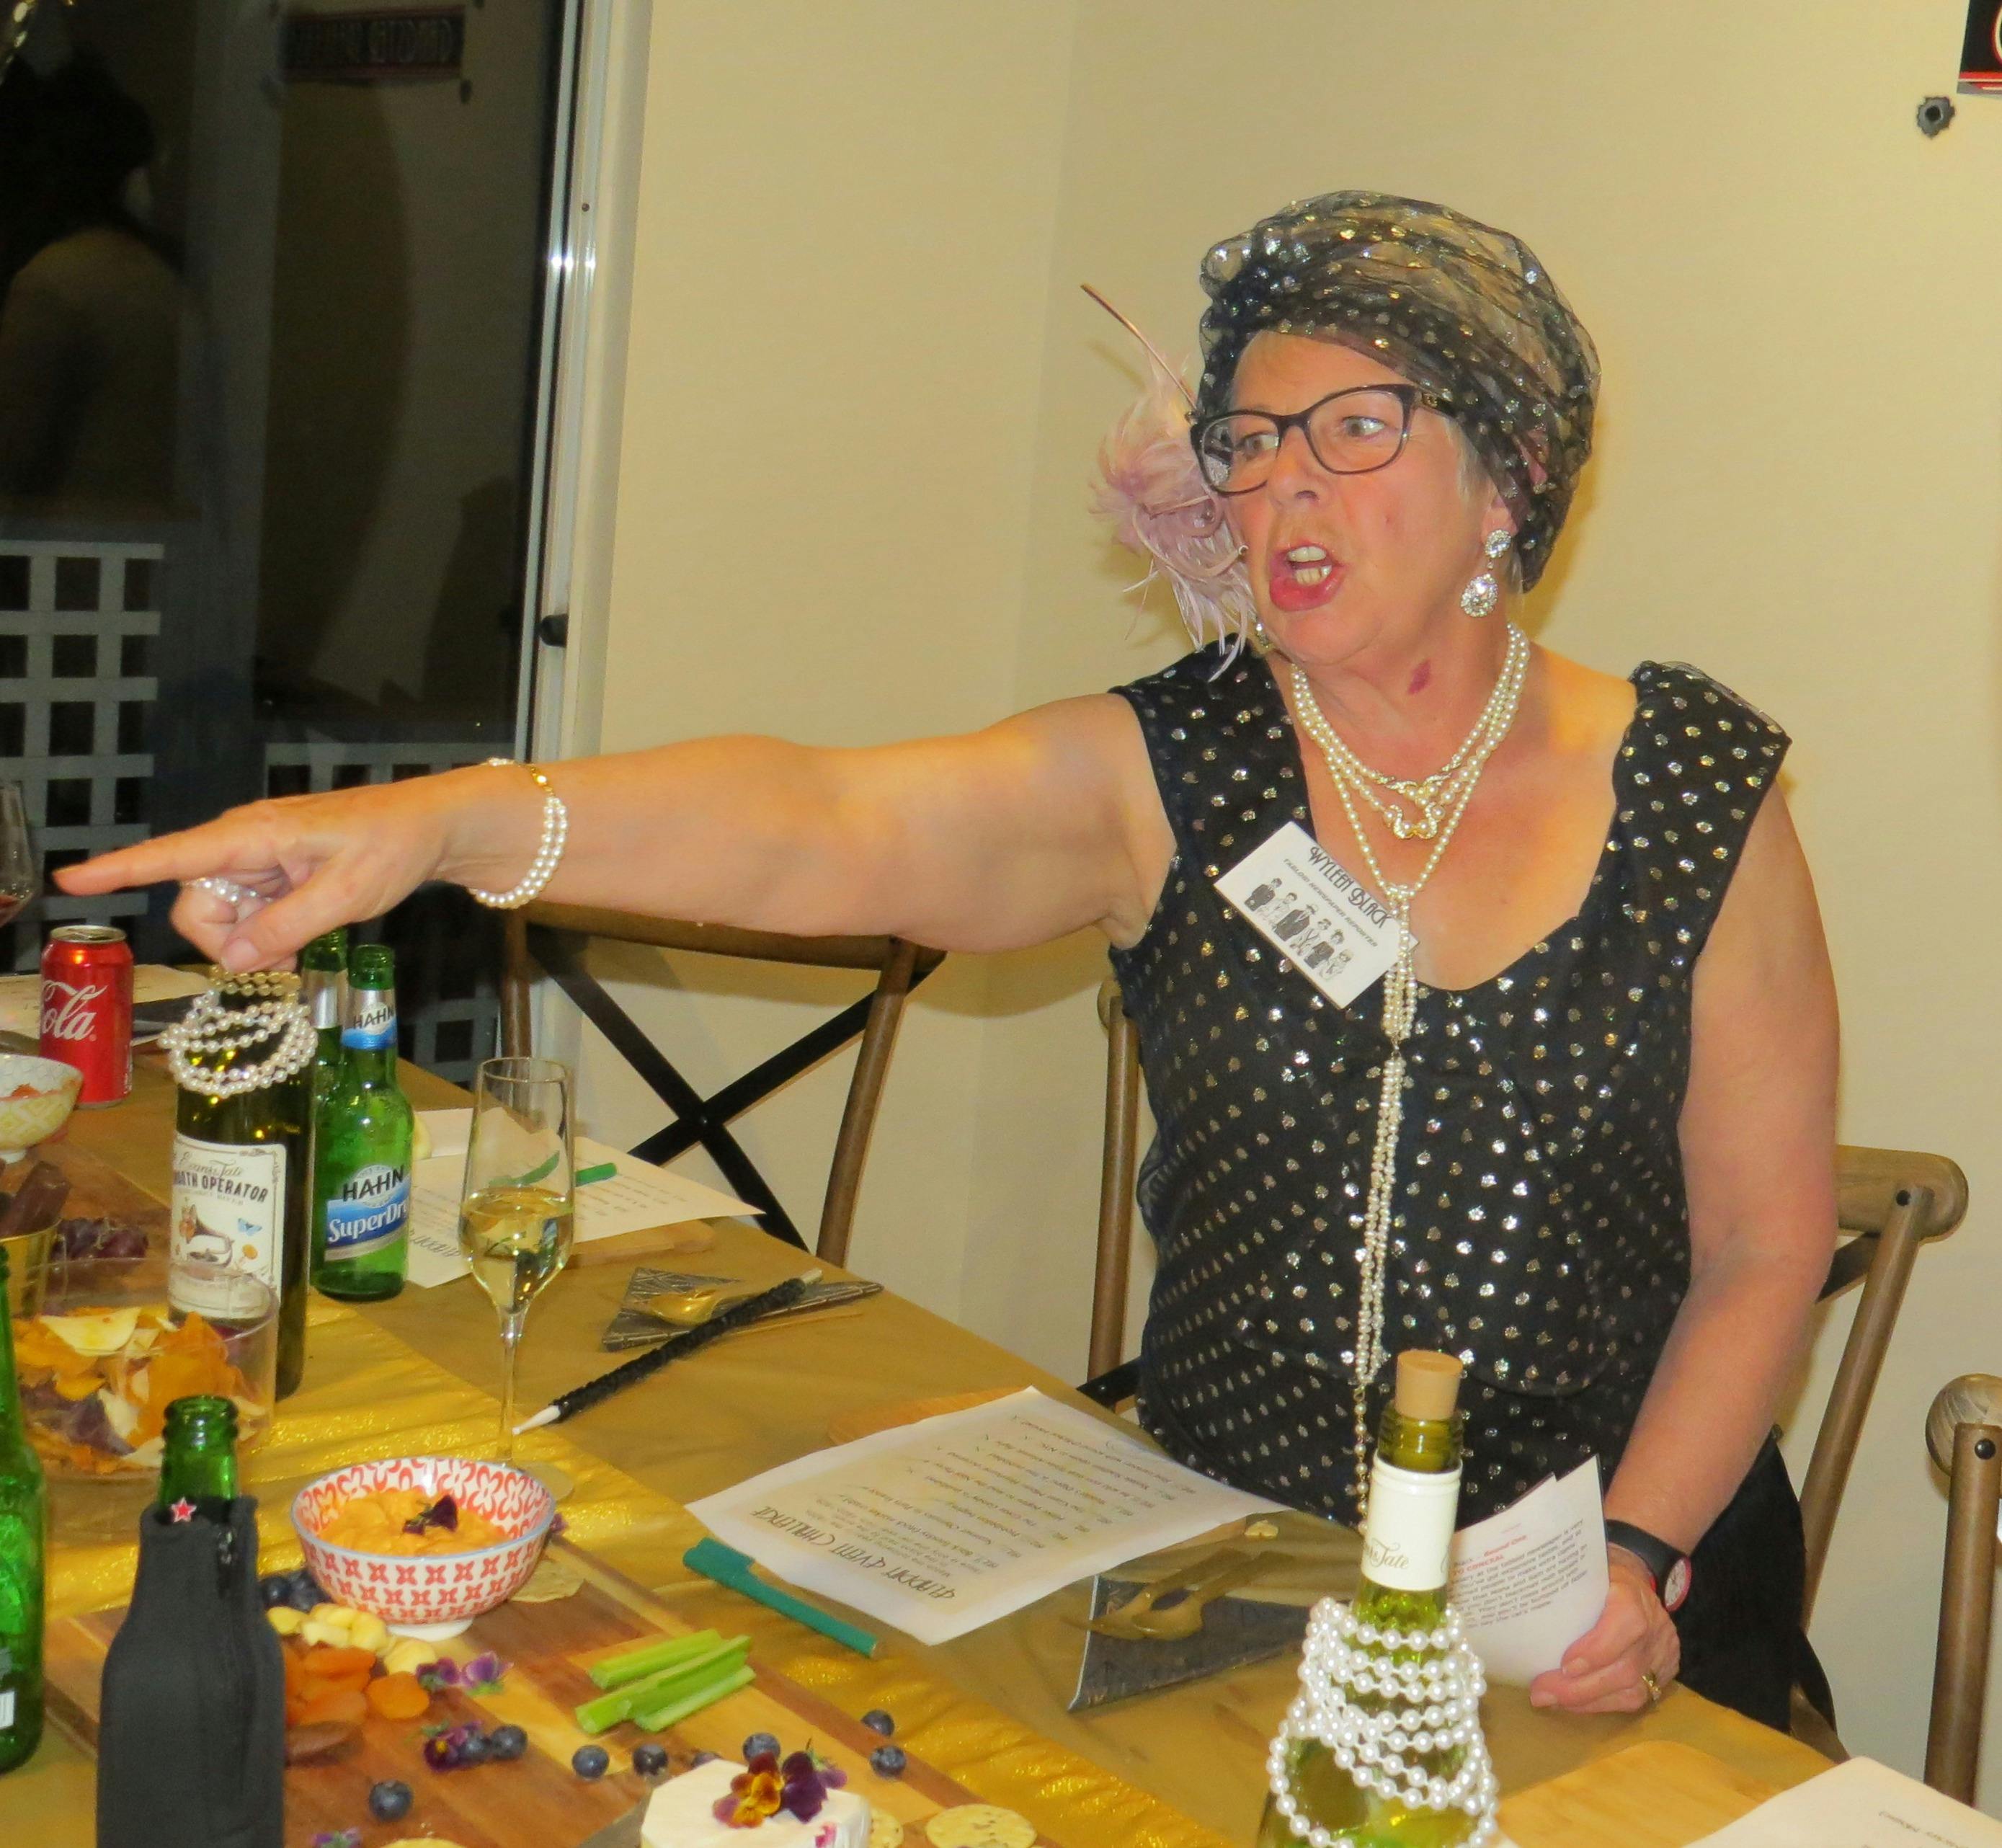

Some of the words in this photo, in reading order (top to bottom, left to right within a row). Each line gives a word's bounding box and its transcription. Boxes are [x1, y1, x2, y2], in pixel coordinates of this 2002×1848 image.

[1309, 845, 1355, 892] WYLEEN
[1349, 887, 1392, 929] BLACK
[202, 1175, 268, 1202] OPERATOR
[343, 1164, 404, 1201] HAHN
[828, 1542, 886, 1570] EVENT
